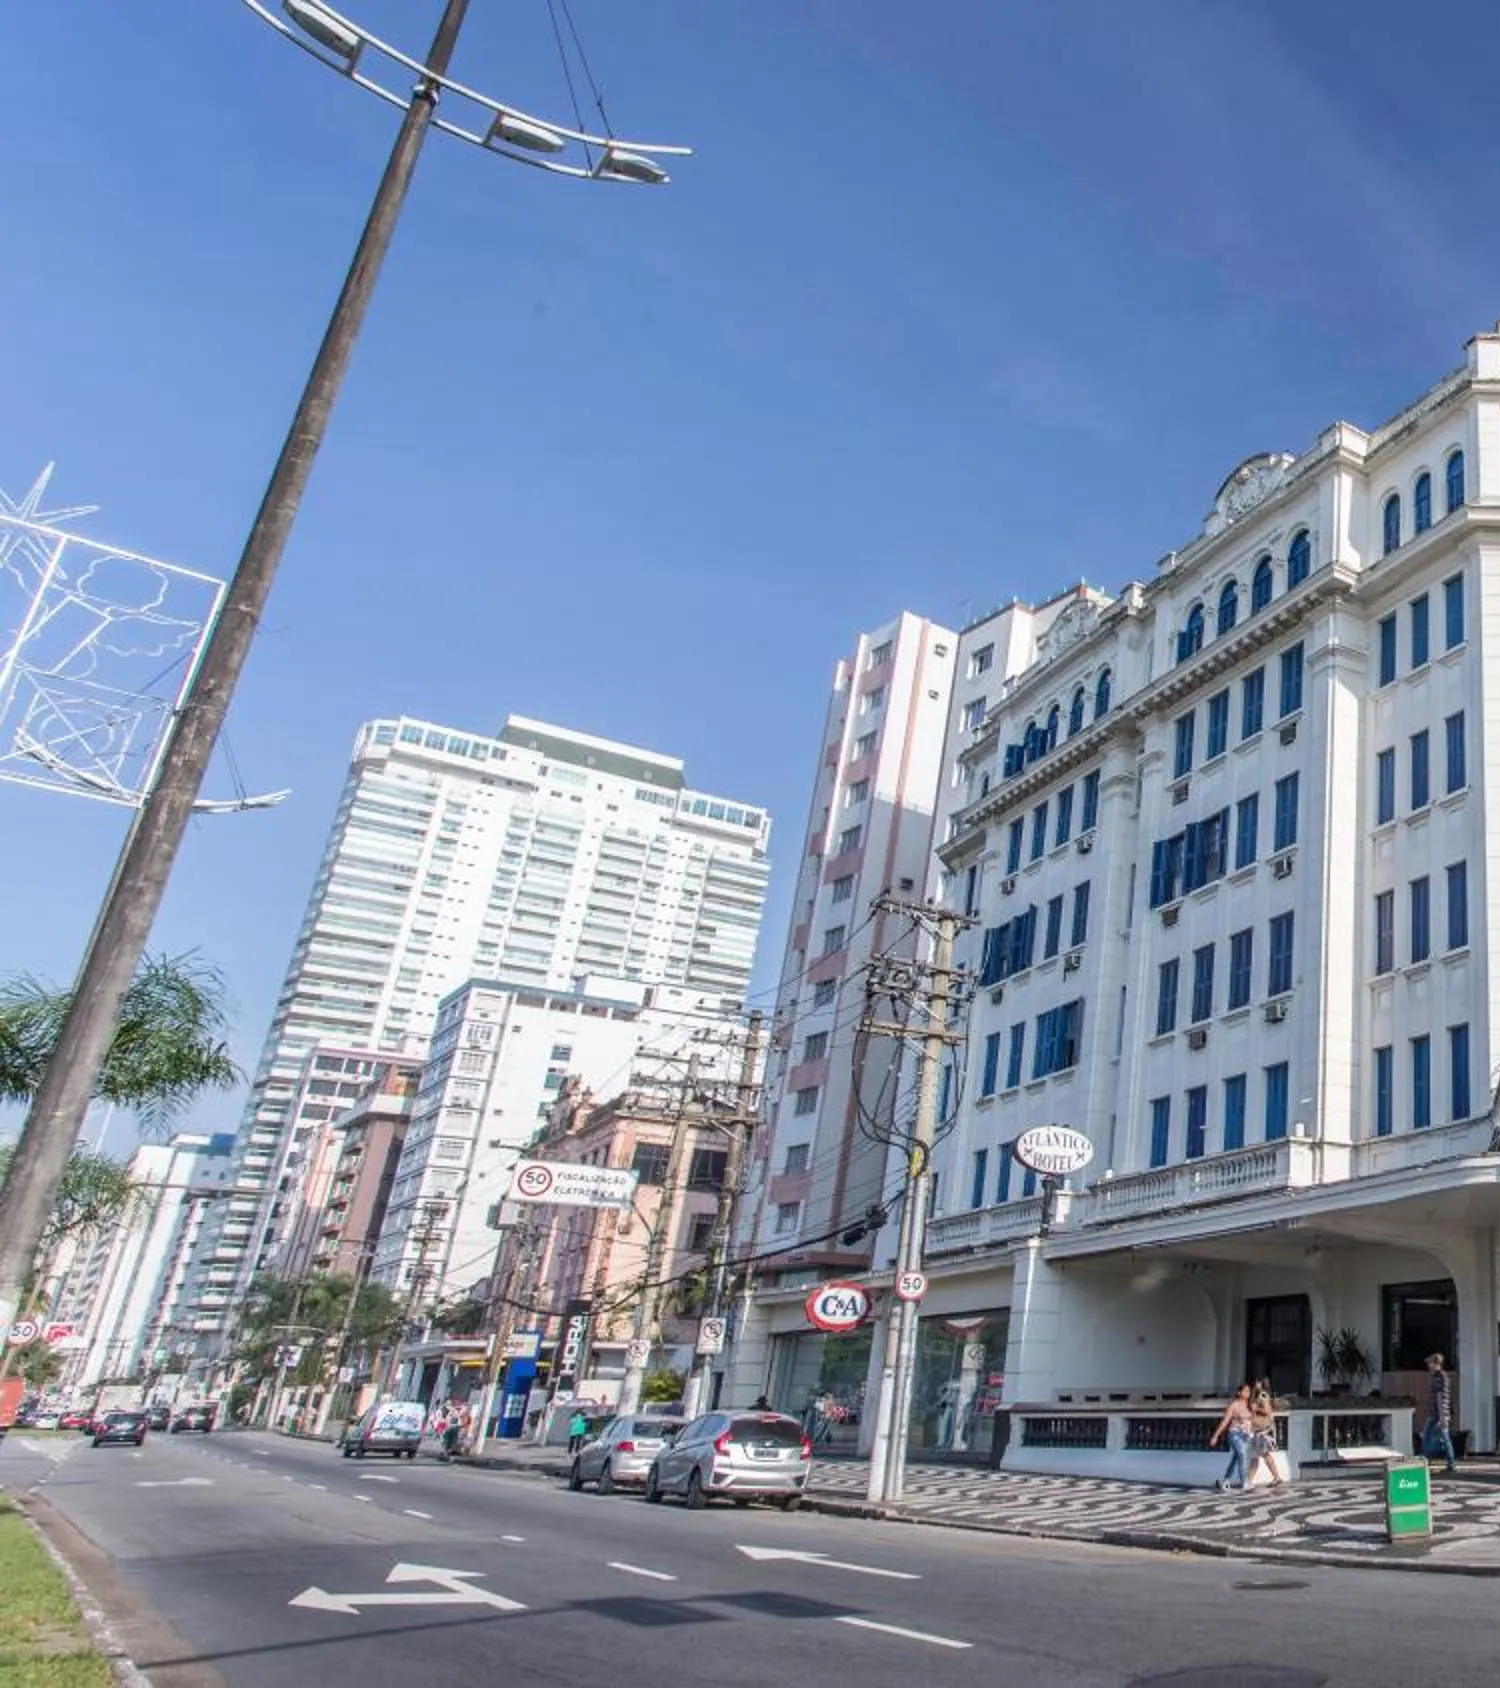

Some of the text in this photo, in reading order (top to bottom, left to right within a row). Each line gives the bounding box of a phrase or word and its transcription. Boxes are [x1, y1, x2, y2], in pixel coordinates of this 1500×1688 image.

[1033, 1151, 1073, 1171] HOTEL
[525, 1171, 547, 1185] 50
[901, 1277, 922, 1290] 50
[820, 1295, 859, 1316] C&A
[10, 1324, 33, 1337] 50
